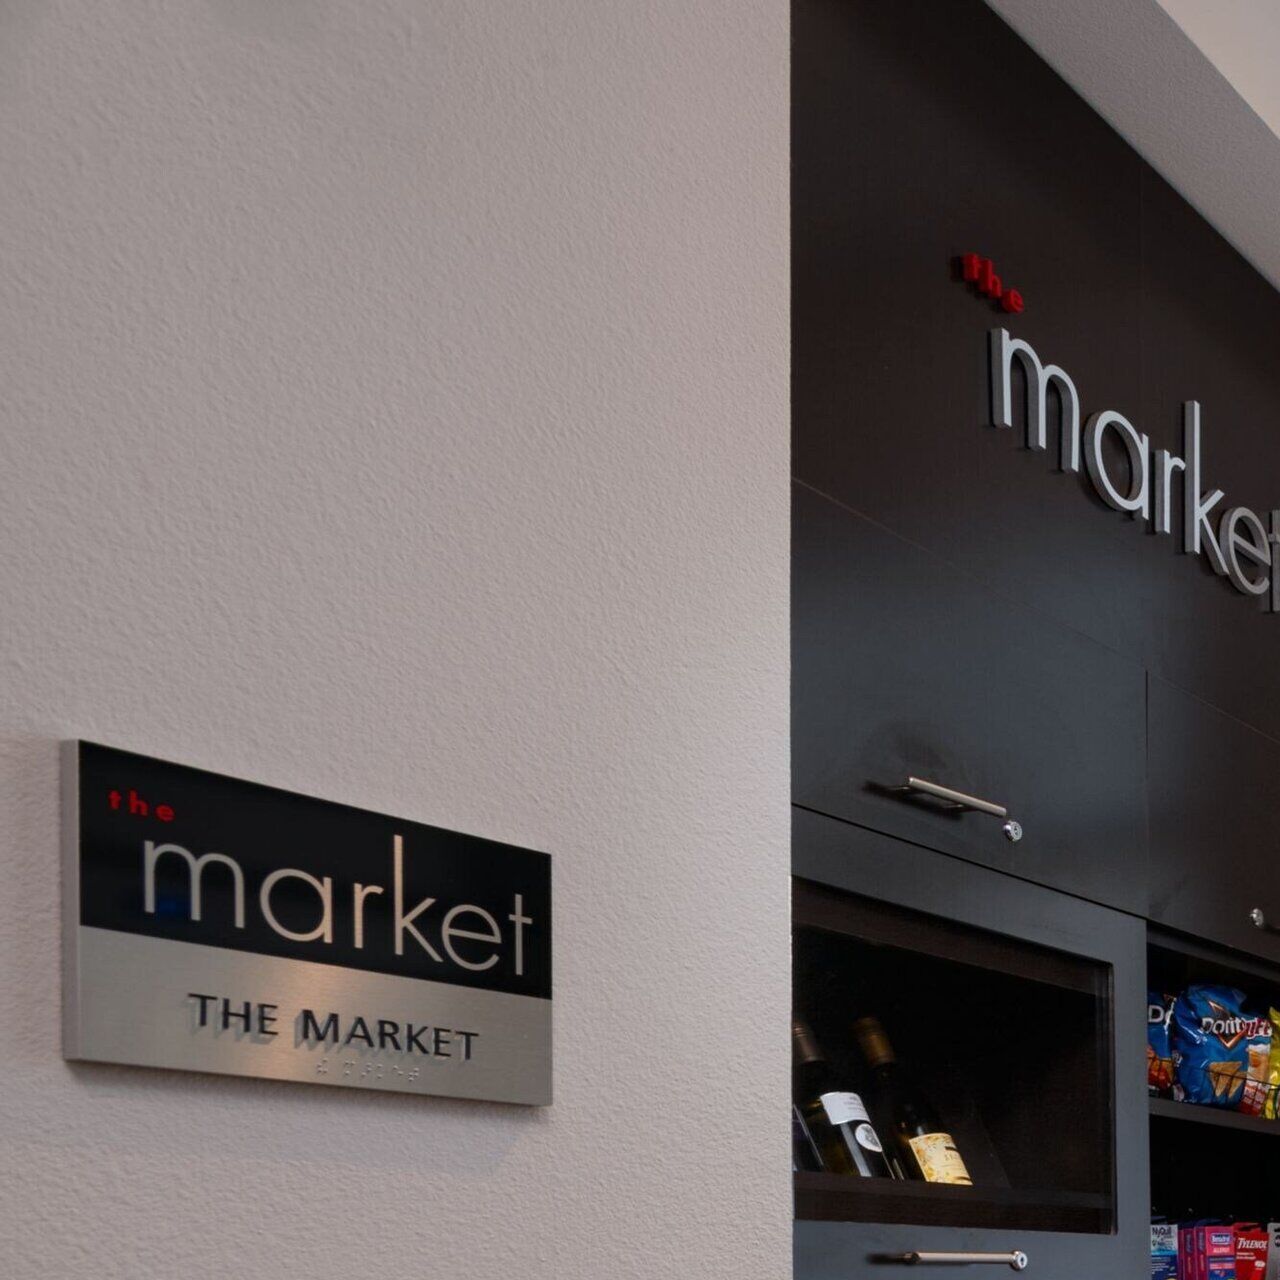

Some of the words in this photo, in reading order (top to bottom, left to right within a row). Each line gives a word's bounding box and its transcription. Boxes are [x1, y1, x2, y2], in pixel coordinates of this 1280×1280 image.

[961, 254, 1024, 313] the
[108, 790, 175, 822] the
[144, 835, 533, 976] market
[187, 993, 279, 1037] THE
[302, 1009, 480, 1061] MARKET
[1237, 1237, 1269, 1250] TYLENOL
